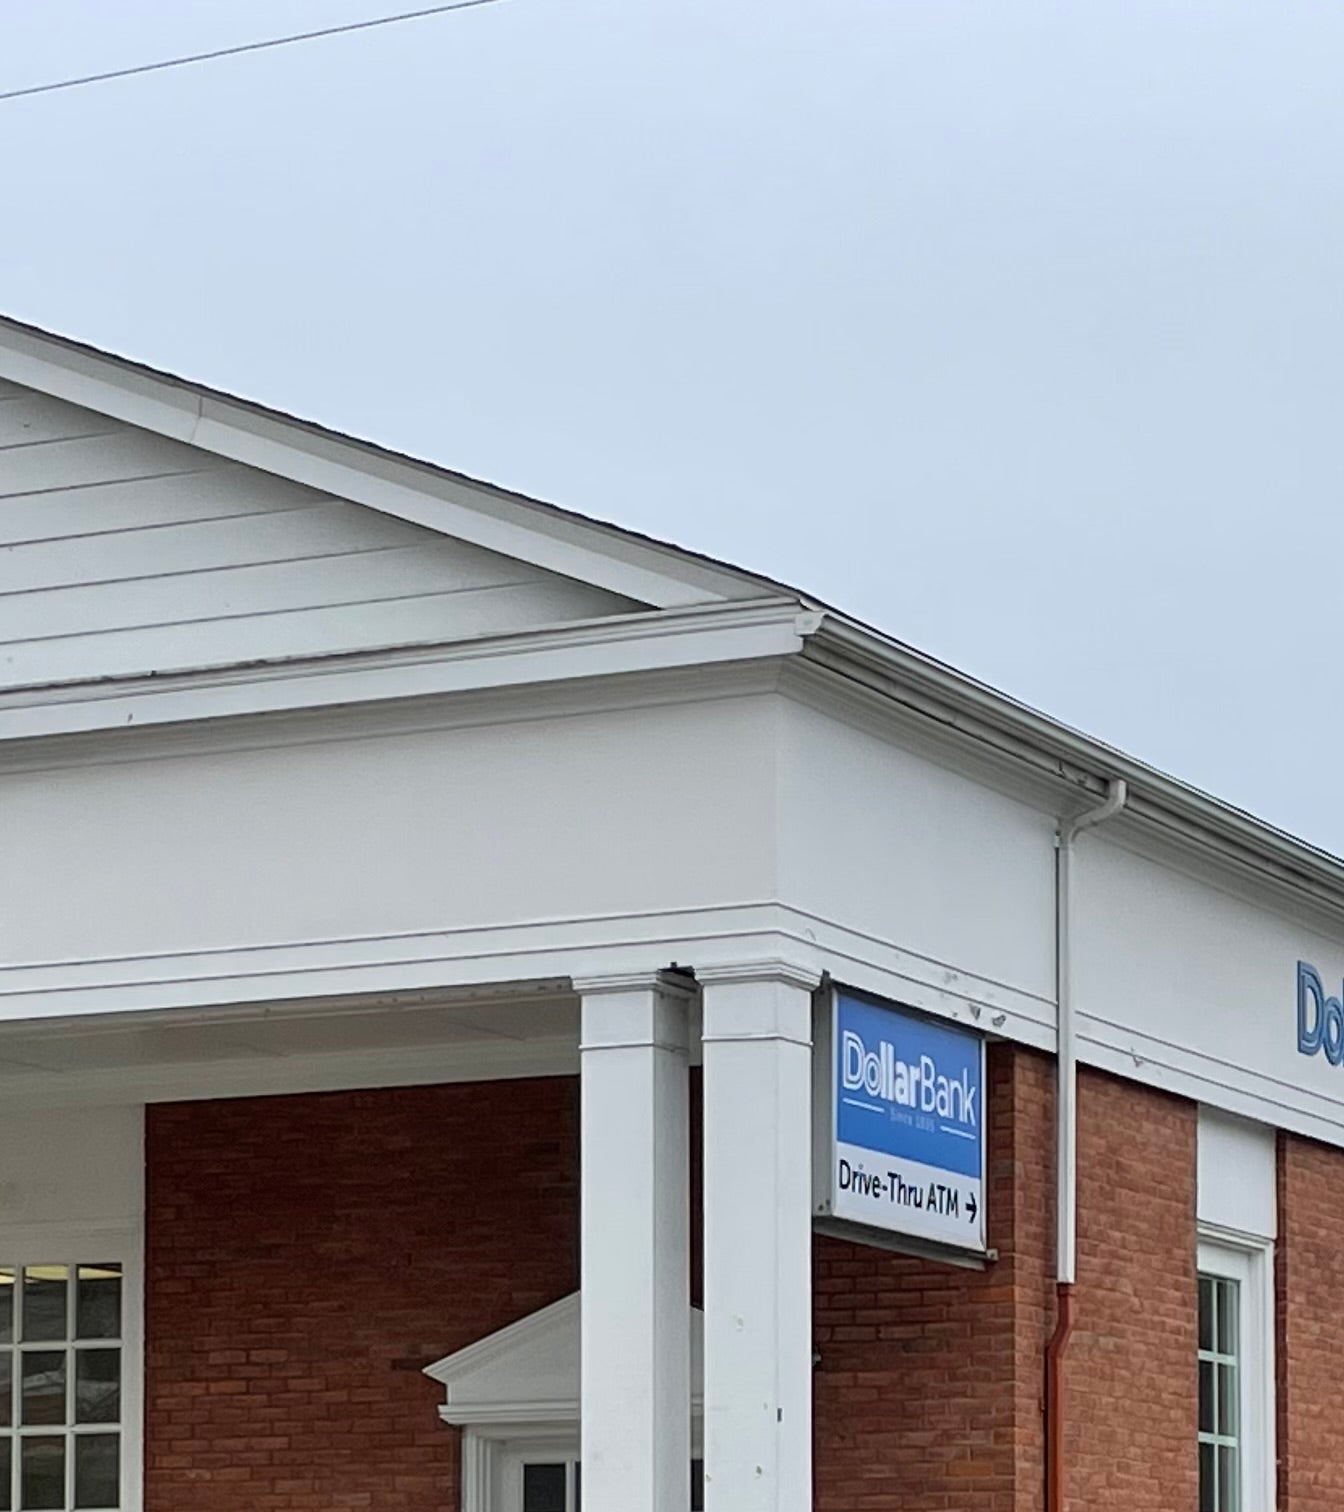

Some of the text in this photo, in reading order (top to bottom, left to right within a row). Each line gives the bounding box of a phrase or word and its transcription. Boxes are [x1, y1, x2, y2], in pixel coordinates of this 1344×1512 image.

[843, 1030, 977, 1127] DollarBank
[839, 1158, 959, 1218] Drive-Thru ATM
